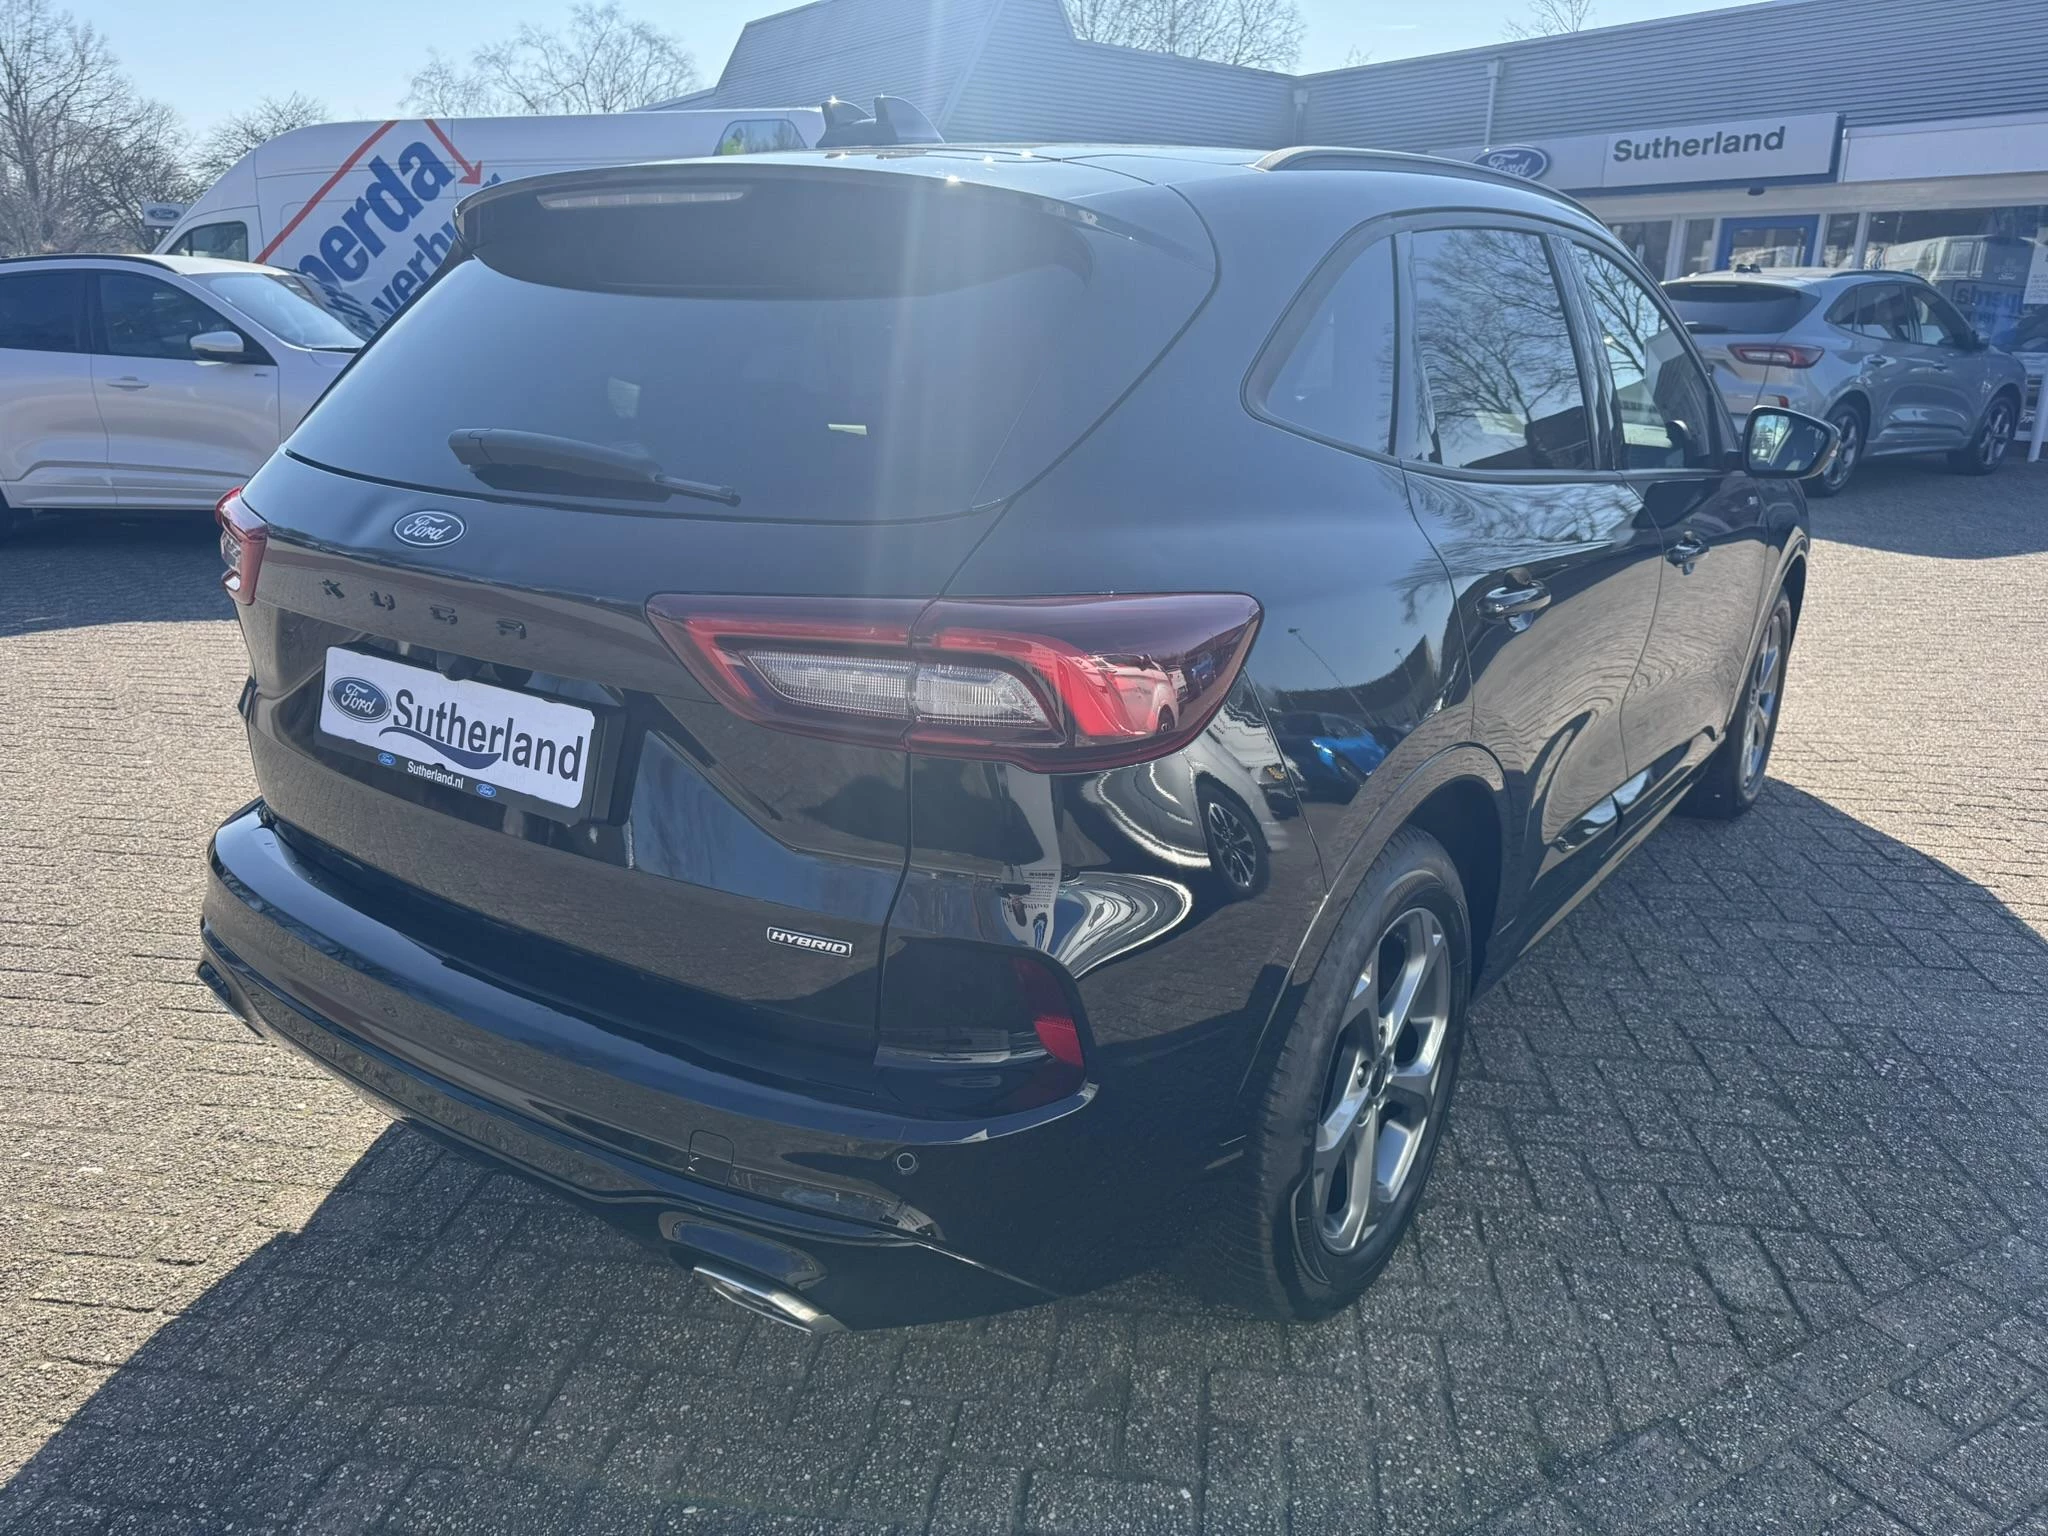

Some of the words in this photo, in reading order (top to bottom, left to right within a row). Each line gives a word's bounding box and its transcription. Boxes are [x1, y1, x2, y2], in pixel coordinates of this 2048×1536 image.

[1612, 126, 1786, 163] Sutherland
[1488, 152, 1532, 176] Ford
[404, 515, 453, 541] Ford
[341, 683, 375, 712] Ford
[393, 688, 584, 783] Sutherland
[407, 760, 465, 790] Sutherland.nl
[771, 931, 847, 954] HYBRID
